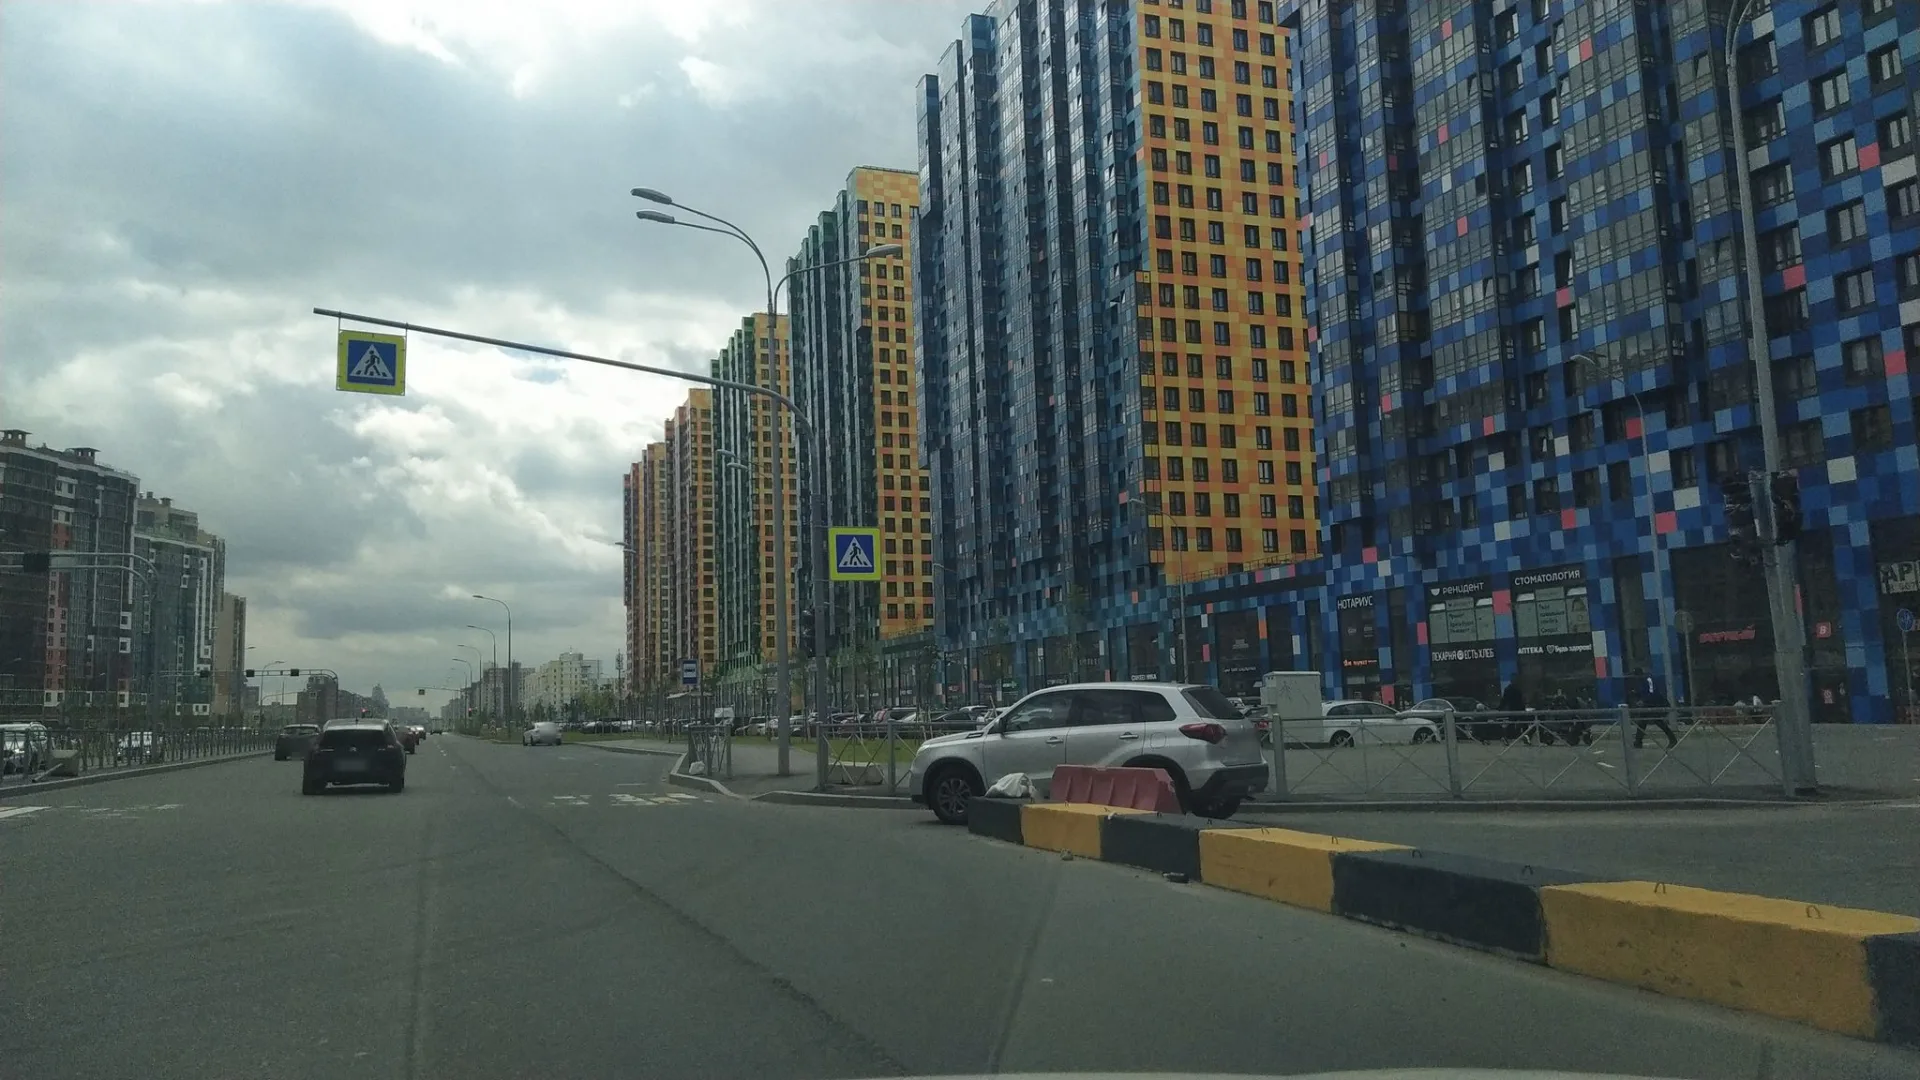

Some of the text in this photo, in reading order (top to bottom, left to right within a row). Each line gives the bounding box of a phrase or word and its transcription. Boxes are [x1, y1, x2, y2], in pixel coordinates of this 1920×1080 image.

[1514, 569, 1580, 586] СТОМАТОЛОГИЯ
[1337, 595, 1374, 610] НОТАРИУС
[1431, 650, 1457, 662] ПЕКАРНЯ
[1478, 647, 1494, 659] ХЛЕБ
[1517, 646, 1544, 655] АПТЕКА
